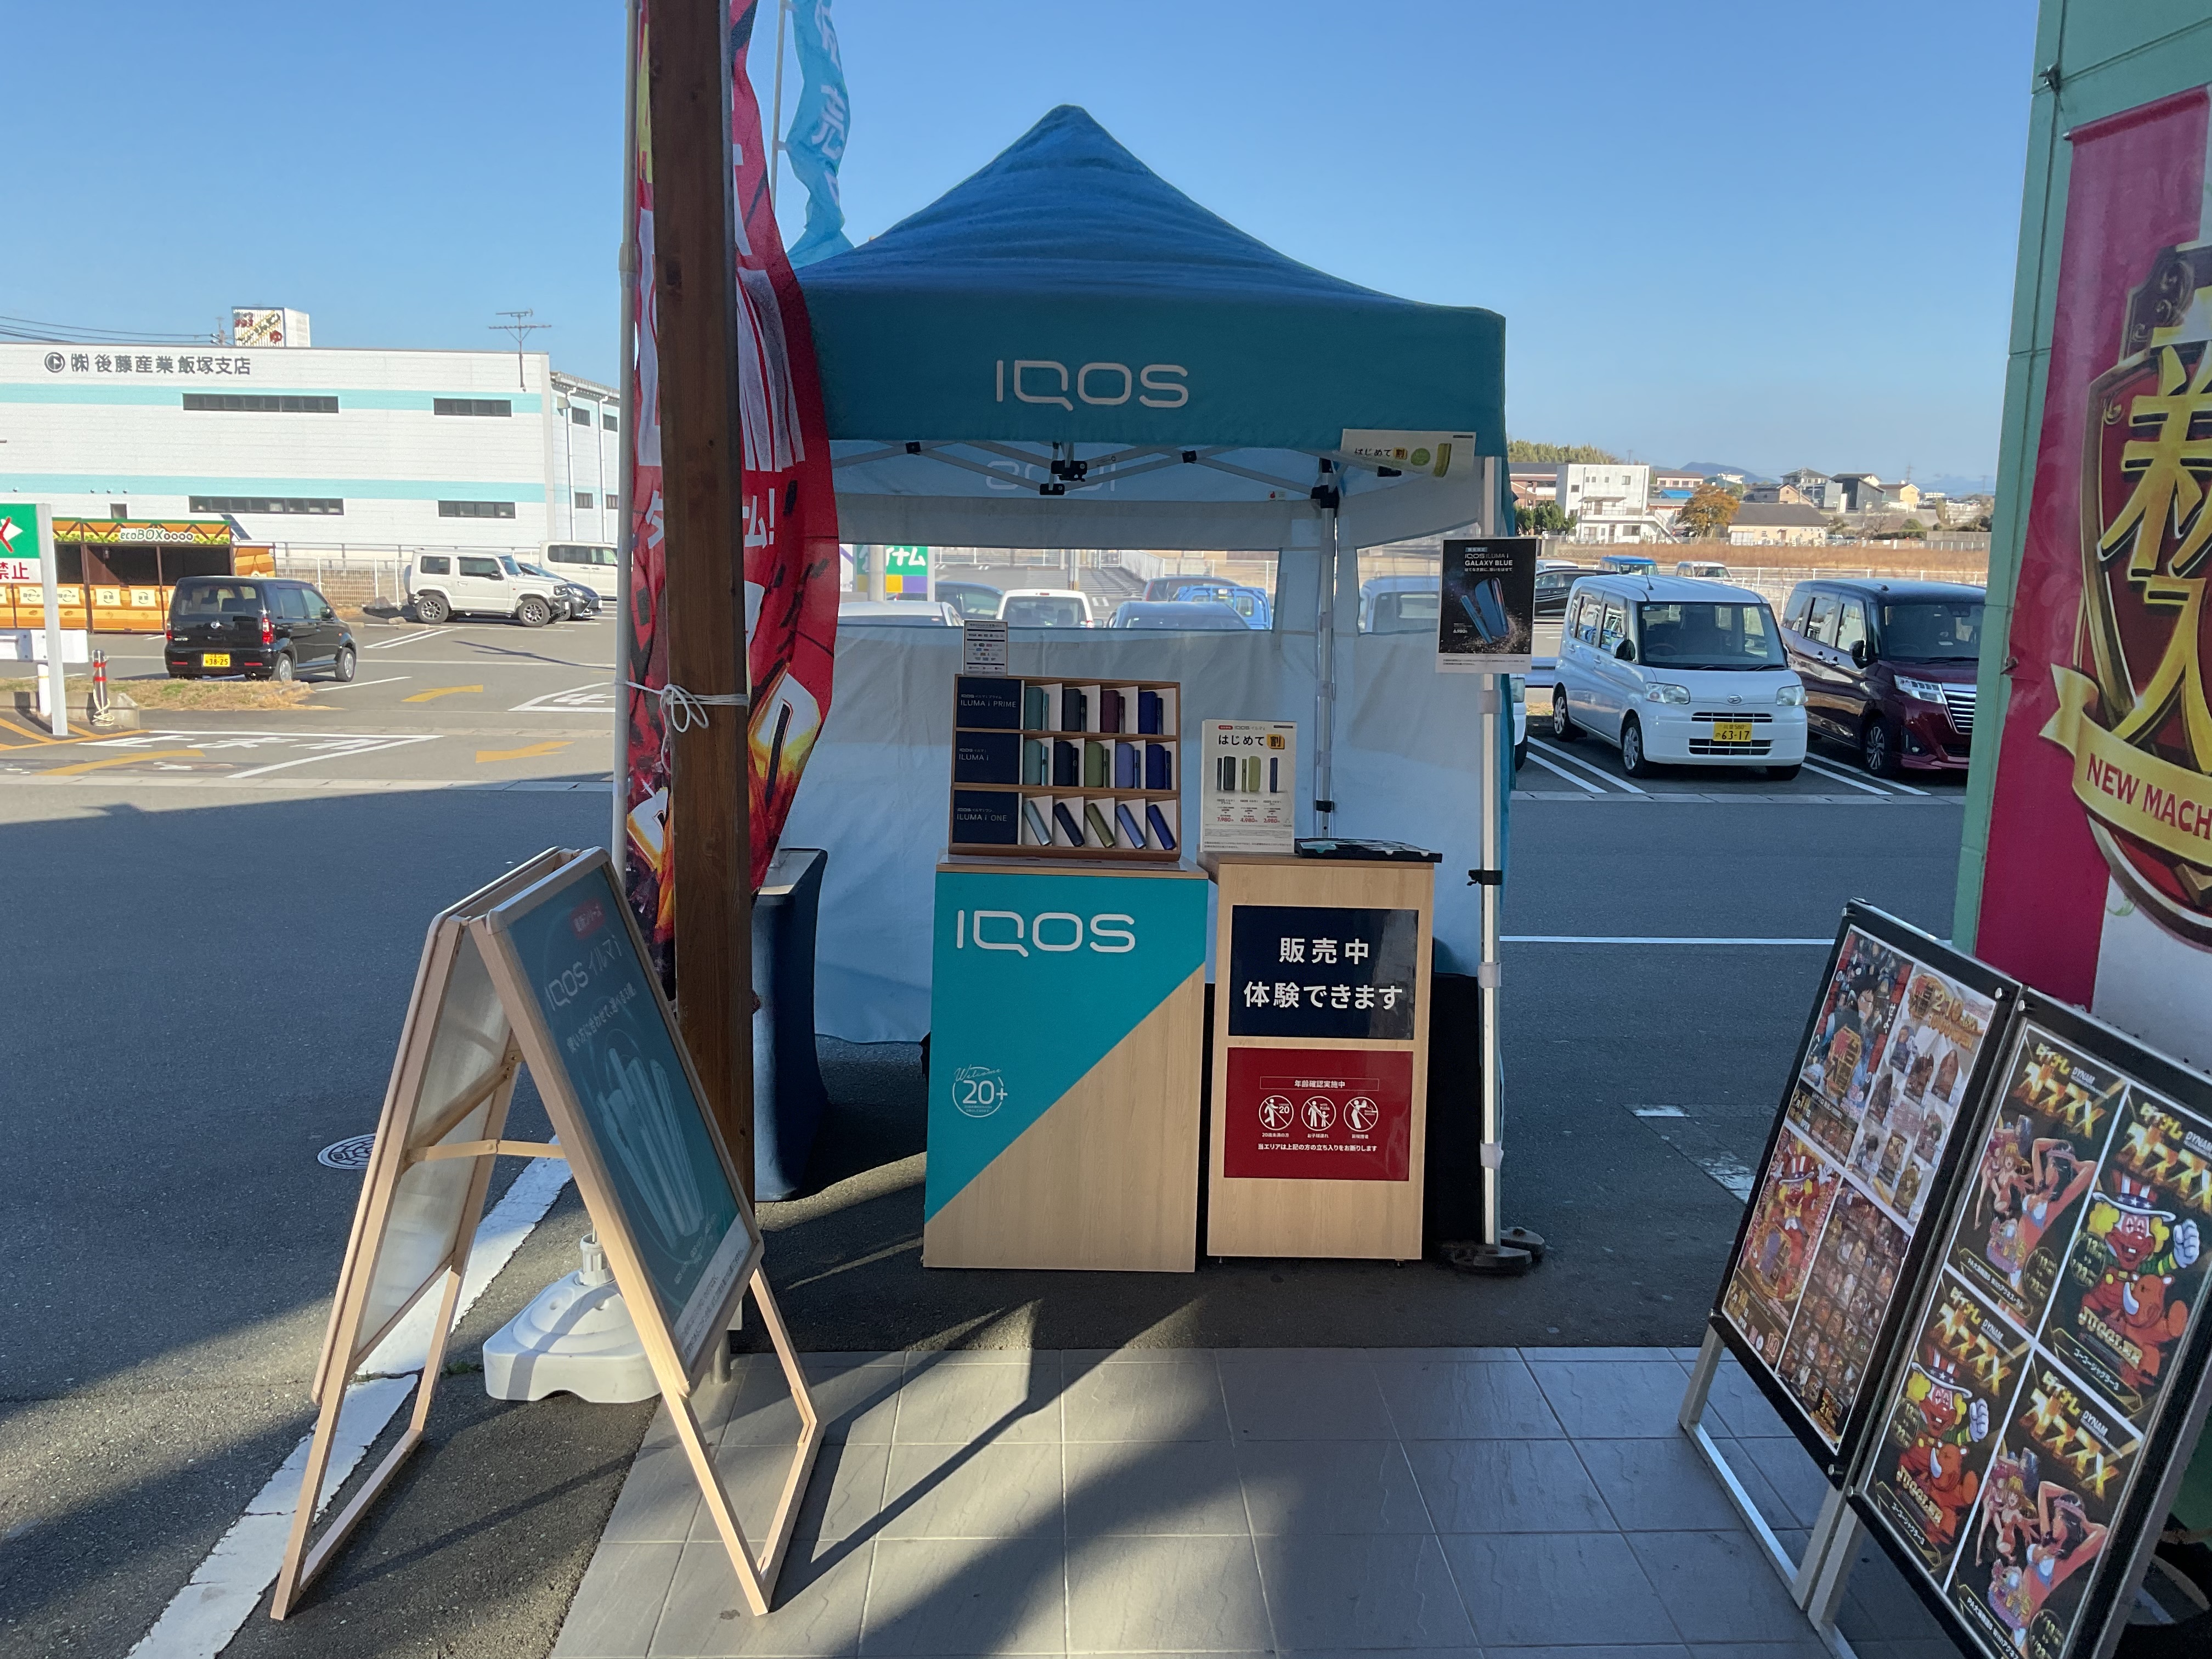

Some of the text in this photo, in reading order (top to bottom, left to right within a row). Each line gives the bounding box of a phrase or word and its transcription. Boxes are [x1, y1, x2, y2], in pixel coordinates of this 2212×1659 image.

[996, 359, 1189, 411] IQOS
[1722, 730, 1750, 740] 63-17
[2086, 752, 2141, 805] NEW
[957, 910, 1136, 957] IQOS
[1279, 937, 1369, 965] 販売中
[544, 961, 589, 1012] IQOS
[1243, 981, 1402, 1009] 体験できます
[1294, 1080, 1346, 1088] 年齢確認実施中
[2072, 1066, 2096, 1085] DYNAM
[963, 1080, 1008, 1104] 20+
[1982, 1318, 2004, 1341] DYNAM
[2082, 1410, 2109, 1436] DYNAM
